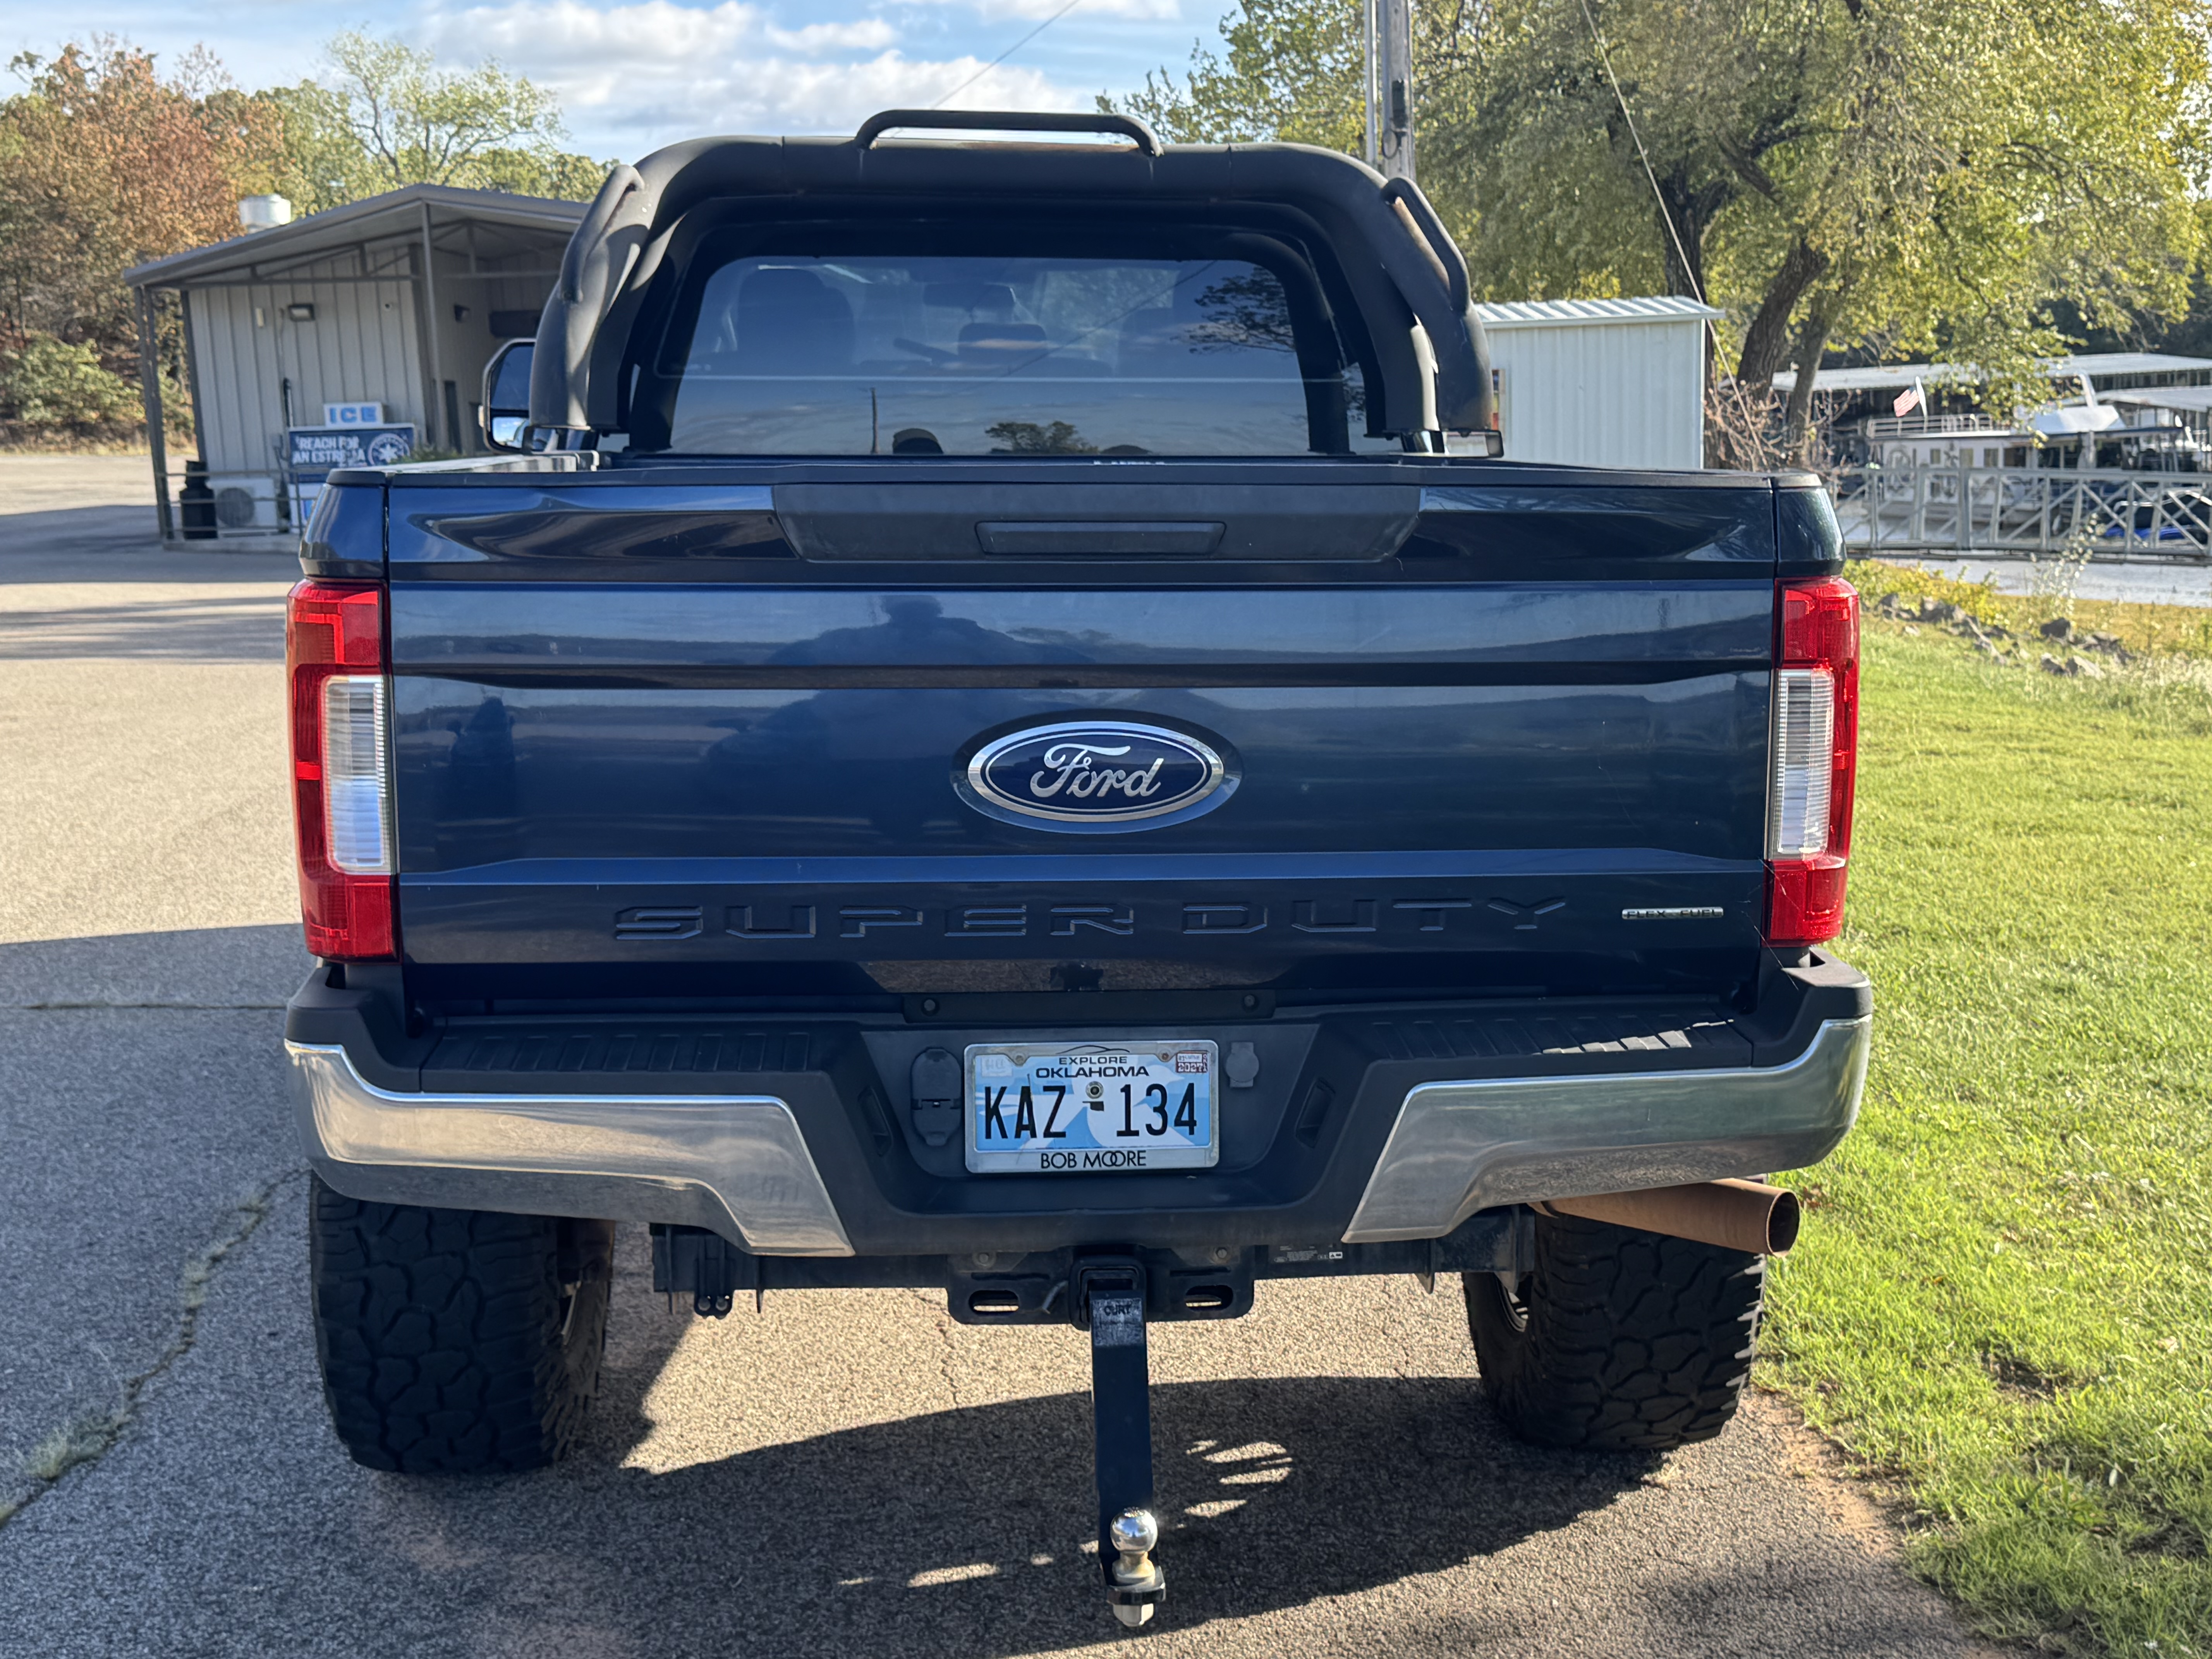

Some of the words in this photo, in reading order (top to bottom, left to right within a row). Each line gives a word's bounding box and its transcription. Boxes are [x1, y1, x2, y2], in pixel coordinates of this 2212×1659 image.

[330, 406, 377, 424] ICE
[1030, 742, 1164, 798] Ford
[615, 902, 1134, 941] SUPER
[1182, 897, 1566, 934] DUTY
[1059, 1056, 1128, 1065] EXPLORE
[1178, 1063, 1203, 1072] 2027
[1036, 1066, 1150, 1079] OKLAHOMA
[984, 1085, 1066, 1140] KAZ
[1116, 1083, 1197, 1137] 134
[1041, 1152, 1077, 1169] BOB
[1083, 1150, 1147, 1168] MOORE
